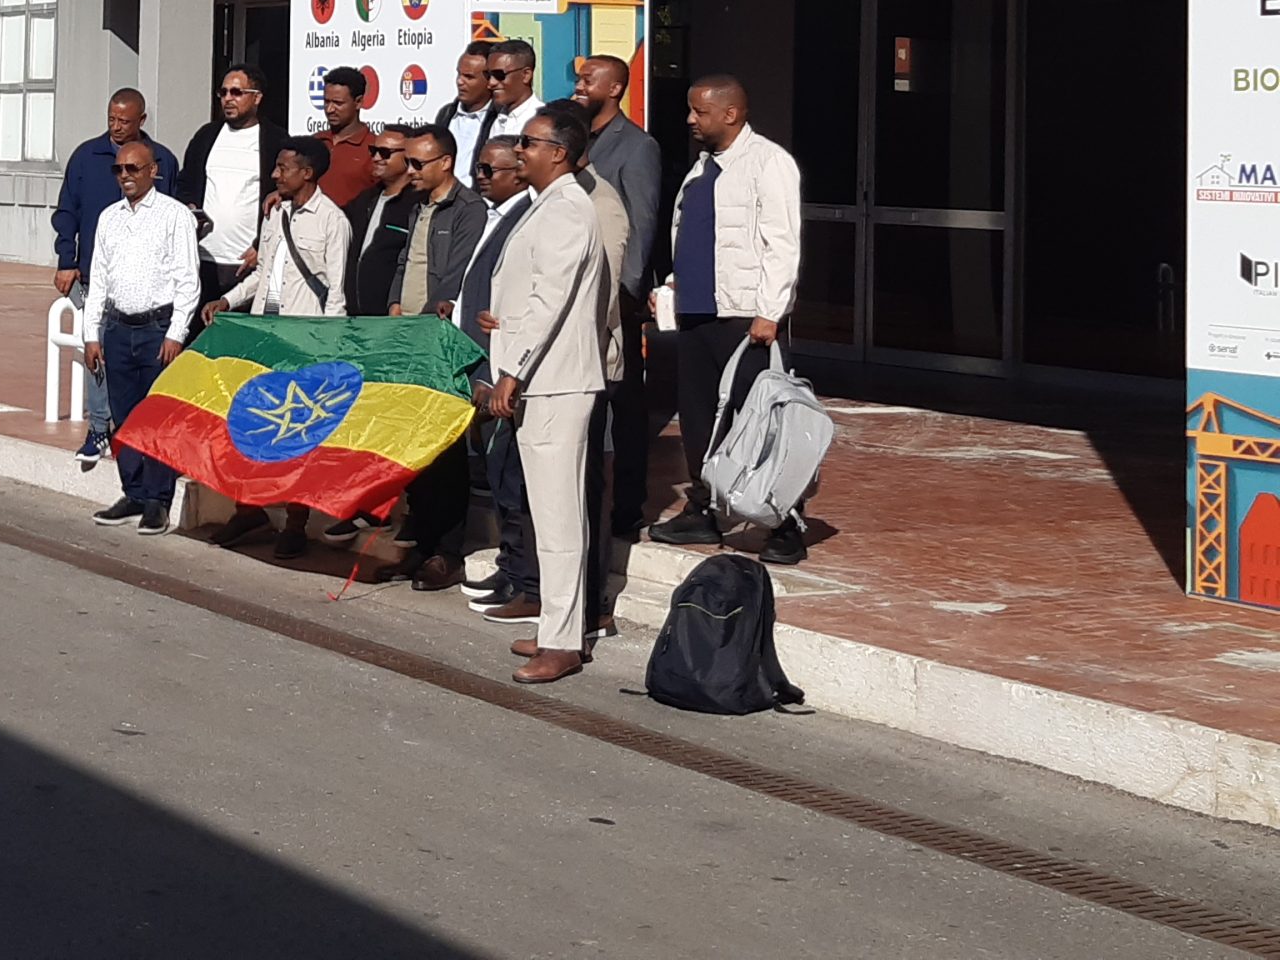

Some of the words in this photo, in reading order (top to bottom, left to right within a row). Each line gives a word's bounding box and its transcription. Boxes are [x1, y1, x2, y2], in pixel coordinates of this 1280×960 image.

[305, 31, 340, 49] Albania
[351, 29, 385, 52] Algeria
[397, 28, 433, 50] Etiopia
[1198, 189, 1230, 201] SISTEMI
